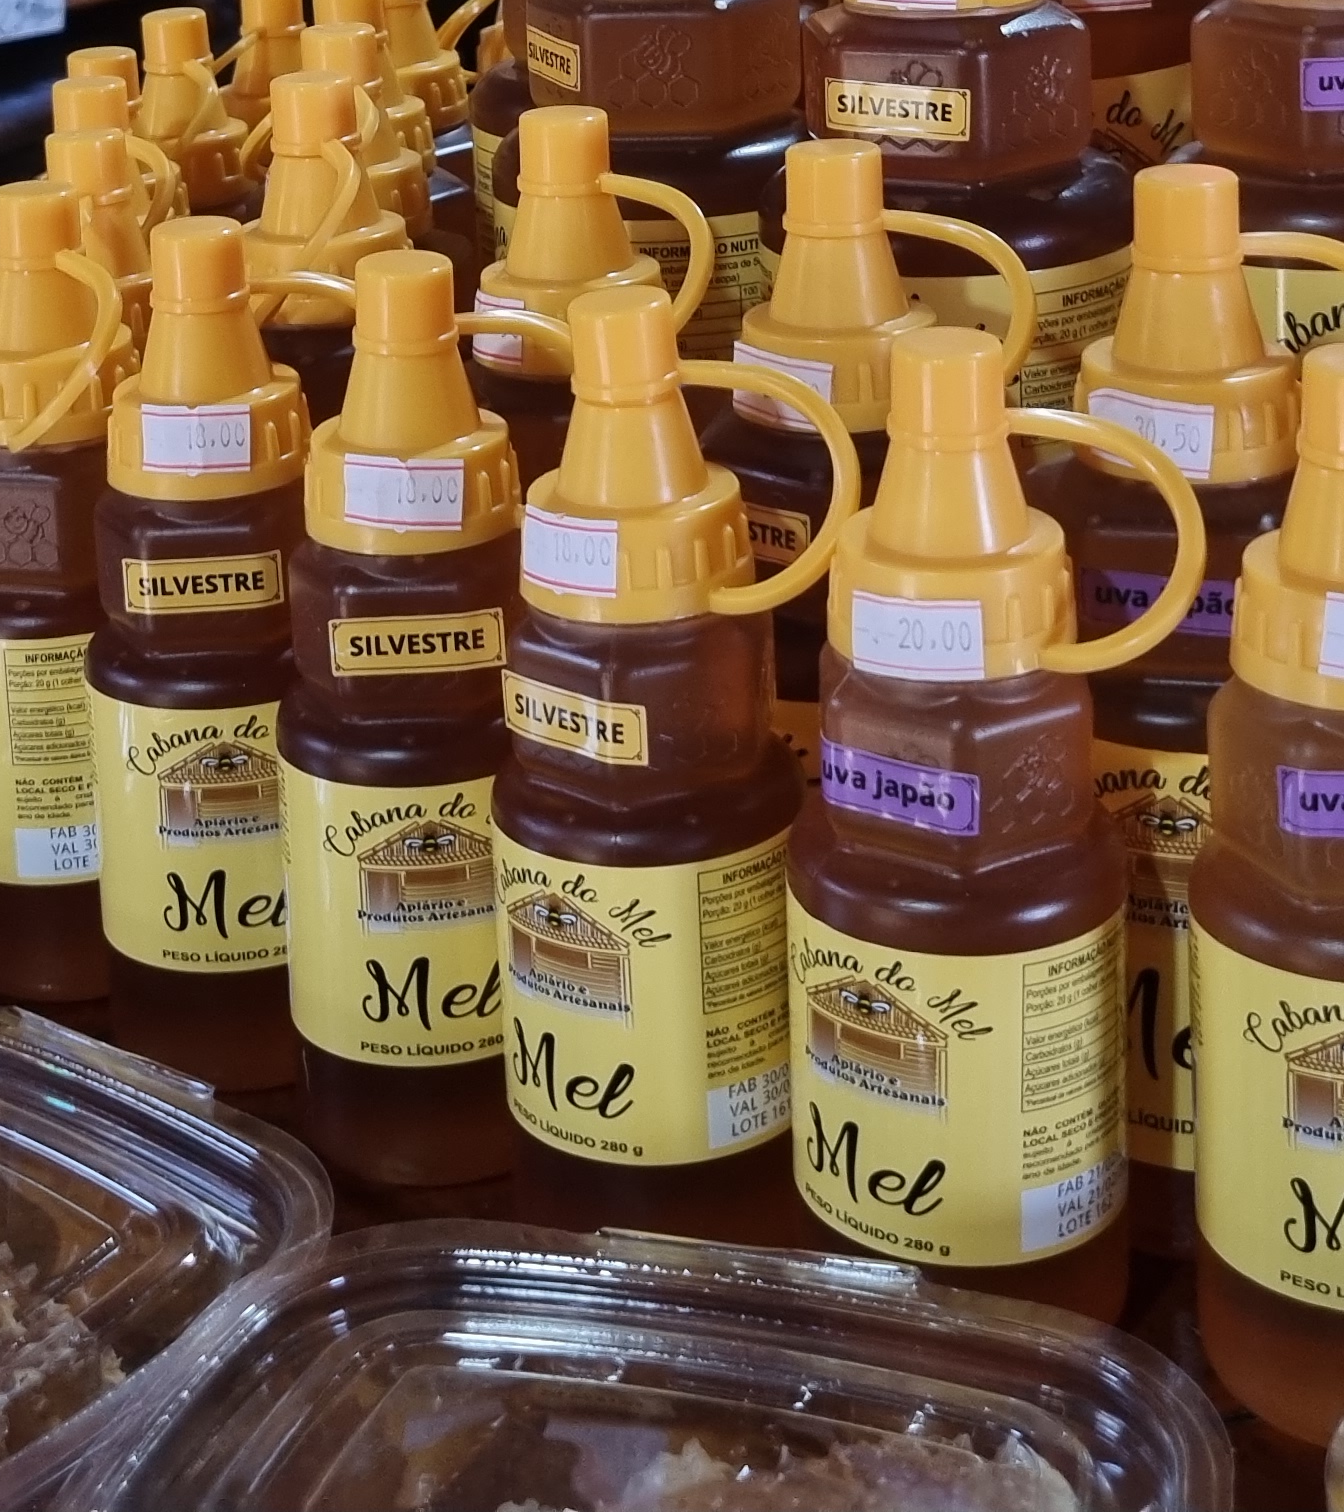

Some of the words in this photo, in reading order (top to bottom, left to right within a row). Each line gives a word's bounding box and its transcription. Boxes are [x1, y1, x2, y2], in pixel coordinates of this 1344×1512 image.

[527, 40, 573, 77] SILVESTRE
[836, 93, 954, 124] SILVESTRE
[1106, 90, 1143, 128] do
[137, 570, 266, 598] SILVESTRE
[1096, 584, 1148, 610] uva
[349, 627, 486, 657] SILVESTRE
[514, 693, 625, 746] SILVESTRE
[126, 720, 224, 778] Cabana
[233, 714, 271, 740] do
[15, 777, 35, 786] NÃO
[42, 775, 83, 787] CONTÉM
[16, 786, 46, 795] LOCAL
[822, 762, 868, 791] uva
[872, 769, 957, 813] japão
[50, 825, 77, 839] FAB
[159, 823, 222, 839] Produtos
[193, 813, 249, 829] Apiário
[323, 802, 429, 858] Cabana
[438, 792, 477, 820] do
[51, 841, 79, 855] VAL
[54, 854, 90, 871] LOTE
[356, 907, 424, 924] Produtos
[395, 899, 454, 912] Apiário
[495, 859, 552, 903] Cabana
[561, 873, 600, 904] do
[608, 898, 673, 949] Mel
[162, 949, 201, 963] PESO
[205, 947, 269, 964] LÍQUIDO
[362, 956, 502, 1032] Mel
[508, 964, 551, 997] Produtos
[552, 988, 631, 1014] Artesanais
[528, 967, 578, 994] Apiário
[789, 937, 864, 984] Cabana
[874, 960, 917, 993] do
[927, 989, 995, 1042] Mel
[360, 1040, 402, 1056] PESO
[407, 1038, 475, 1057] LÍQUIDO
[512, 1016, 635, 1120] Mel
[804, 1044, 858, 1085] Produtos
[859, 1078, 946, 1108] Artesanais
[830, 1054, 887, 1082] Apiário
[728, 1078, 758, 1099] FAB
[729, 1099, 758, 1118] VAL
[512, 1098, 538, 1127] PESO
[540, 1119, 597, 1149] LÍQUIDO
[600, 1138, 629, 1155] 280
[633, 1145, 644, 1158] g
[731, 1114, 768, 1138] LOTE
[806, 1101, 948, 1217] Mel
[1058, 1176, 1084, 1198] FAB
[804, 1182, 833, 1216] PESO
[834, 1208, 900, 1246] LÍQUIDO
[903, 1236, 933, 1254] 280
[938, 1243, 951, 1257] g
[1057, 1196, 1084, 1217] VAL
[1058, 1210, 1092, 1238] LOTE
[1279, 1269, 1331, 1296] PESO
